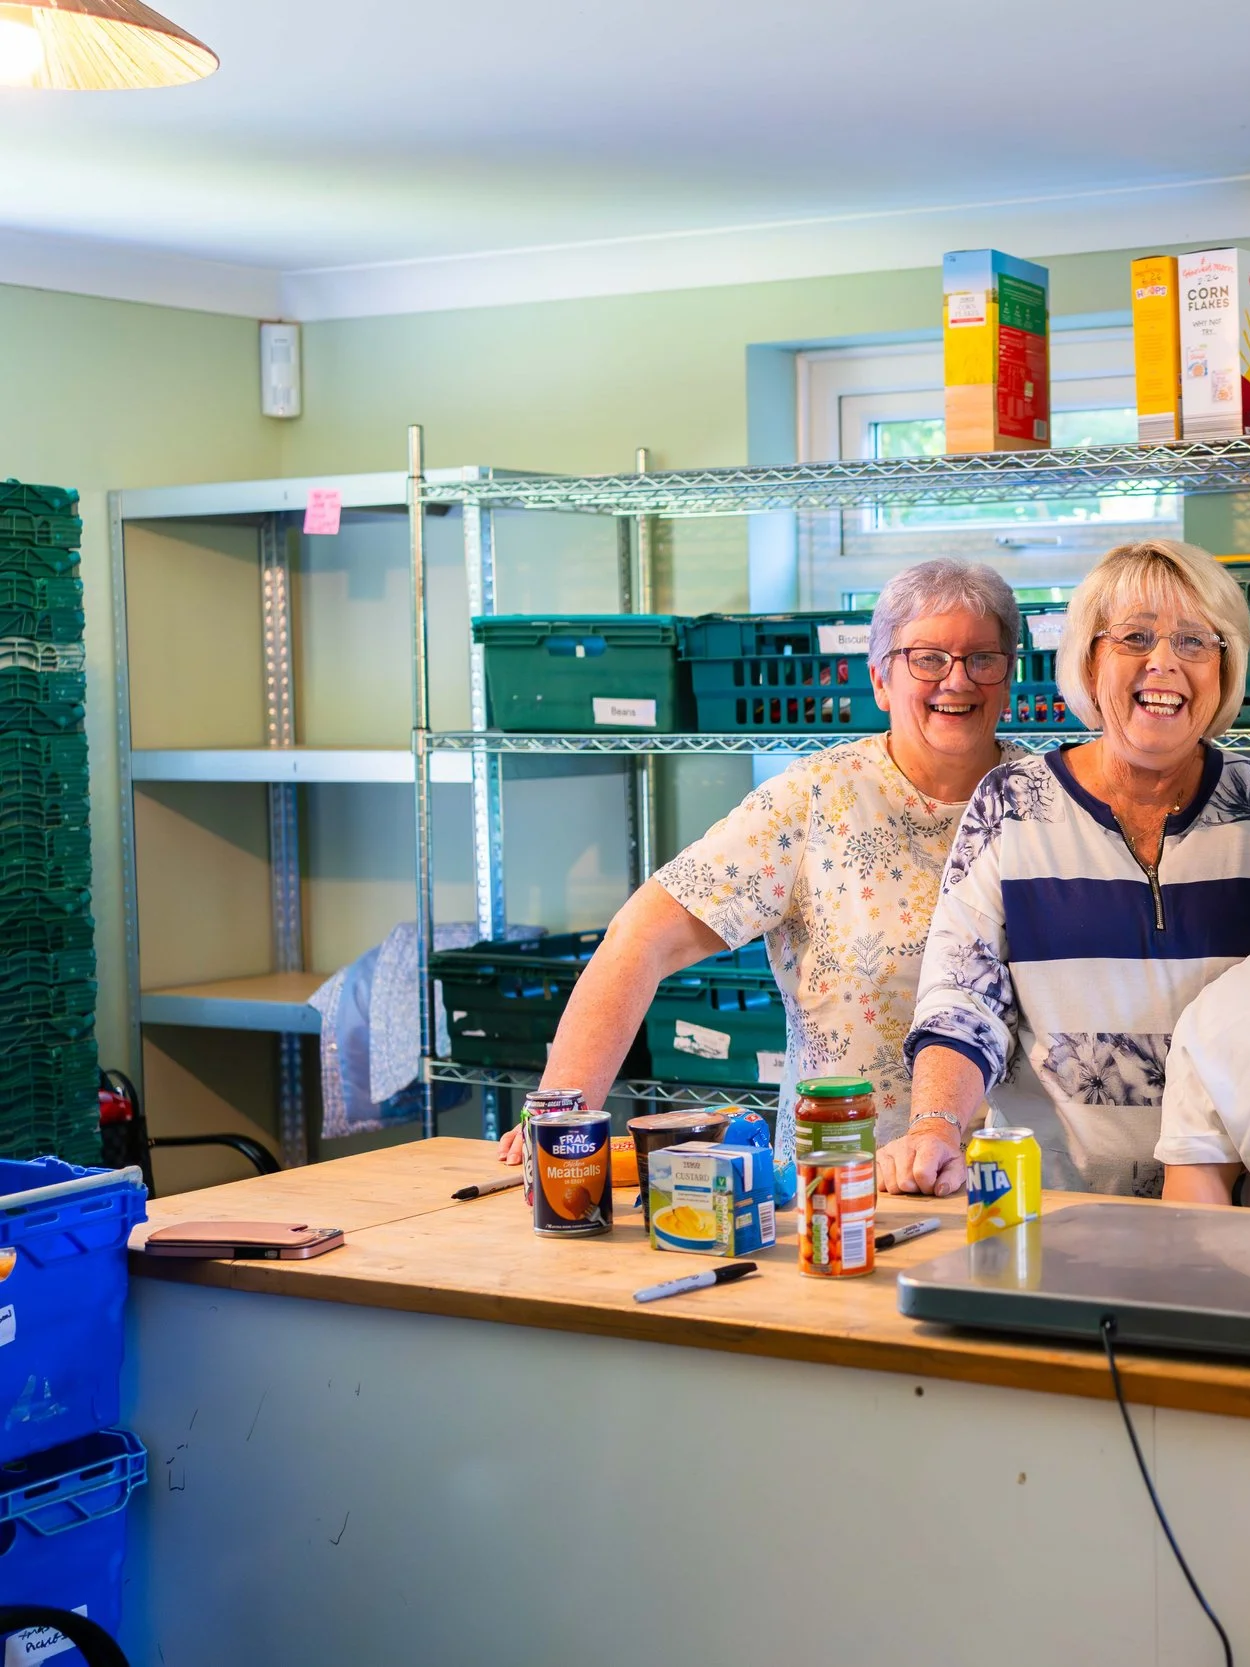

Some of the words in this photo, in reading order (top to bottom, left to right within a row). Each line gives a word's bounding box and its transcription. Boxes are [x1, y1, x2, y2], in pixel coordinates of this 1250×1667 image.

[1137, 287, 1166, 299] HOOPS
[1188, 286, 1229, 301] CORN
[1188, 299, 1229, 312] FLAKES
[611, 706, 636, 717] Beans
[559, 1134, 589, 1146] FRAY
[552, 1142, 596, 1155] BENTOS
[547, 1164, 601, 1178] Meatballs
[675, 1172, 709, 1182] CUSTARD
